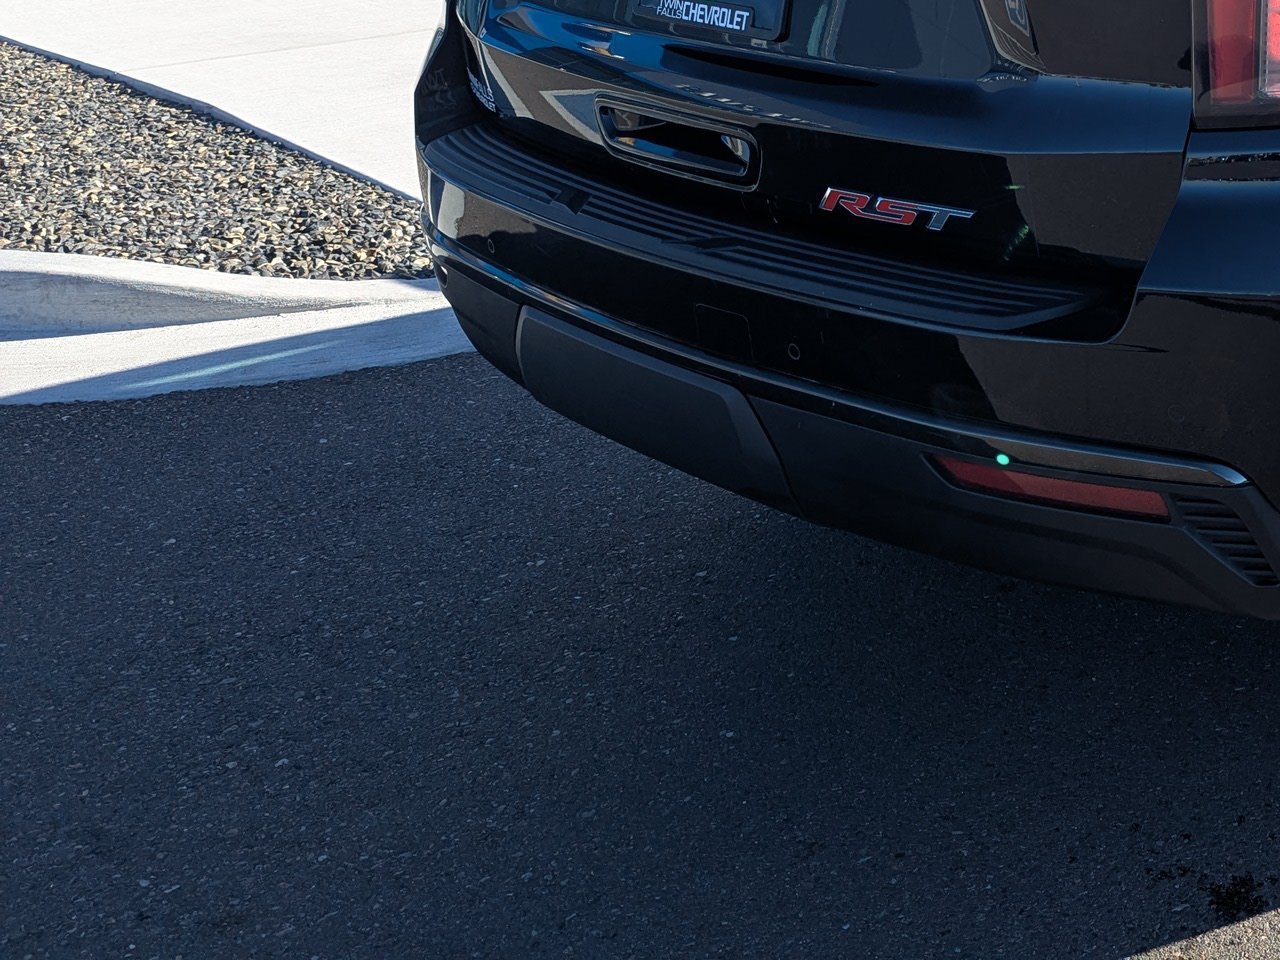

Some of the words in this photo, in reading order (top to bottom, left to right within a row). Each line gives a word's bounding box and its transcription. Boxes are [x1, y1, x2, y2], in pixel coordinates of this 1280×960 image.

[656, 6, 682, 19] FALLS
[682, 1, 750, 31] CHEVROLET
[819, 187, 977, 231] RST
